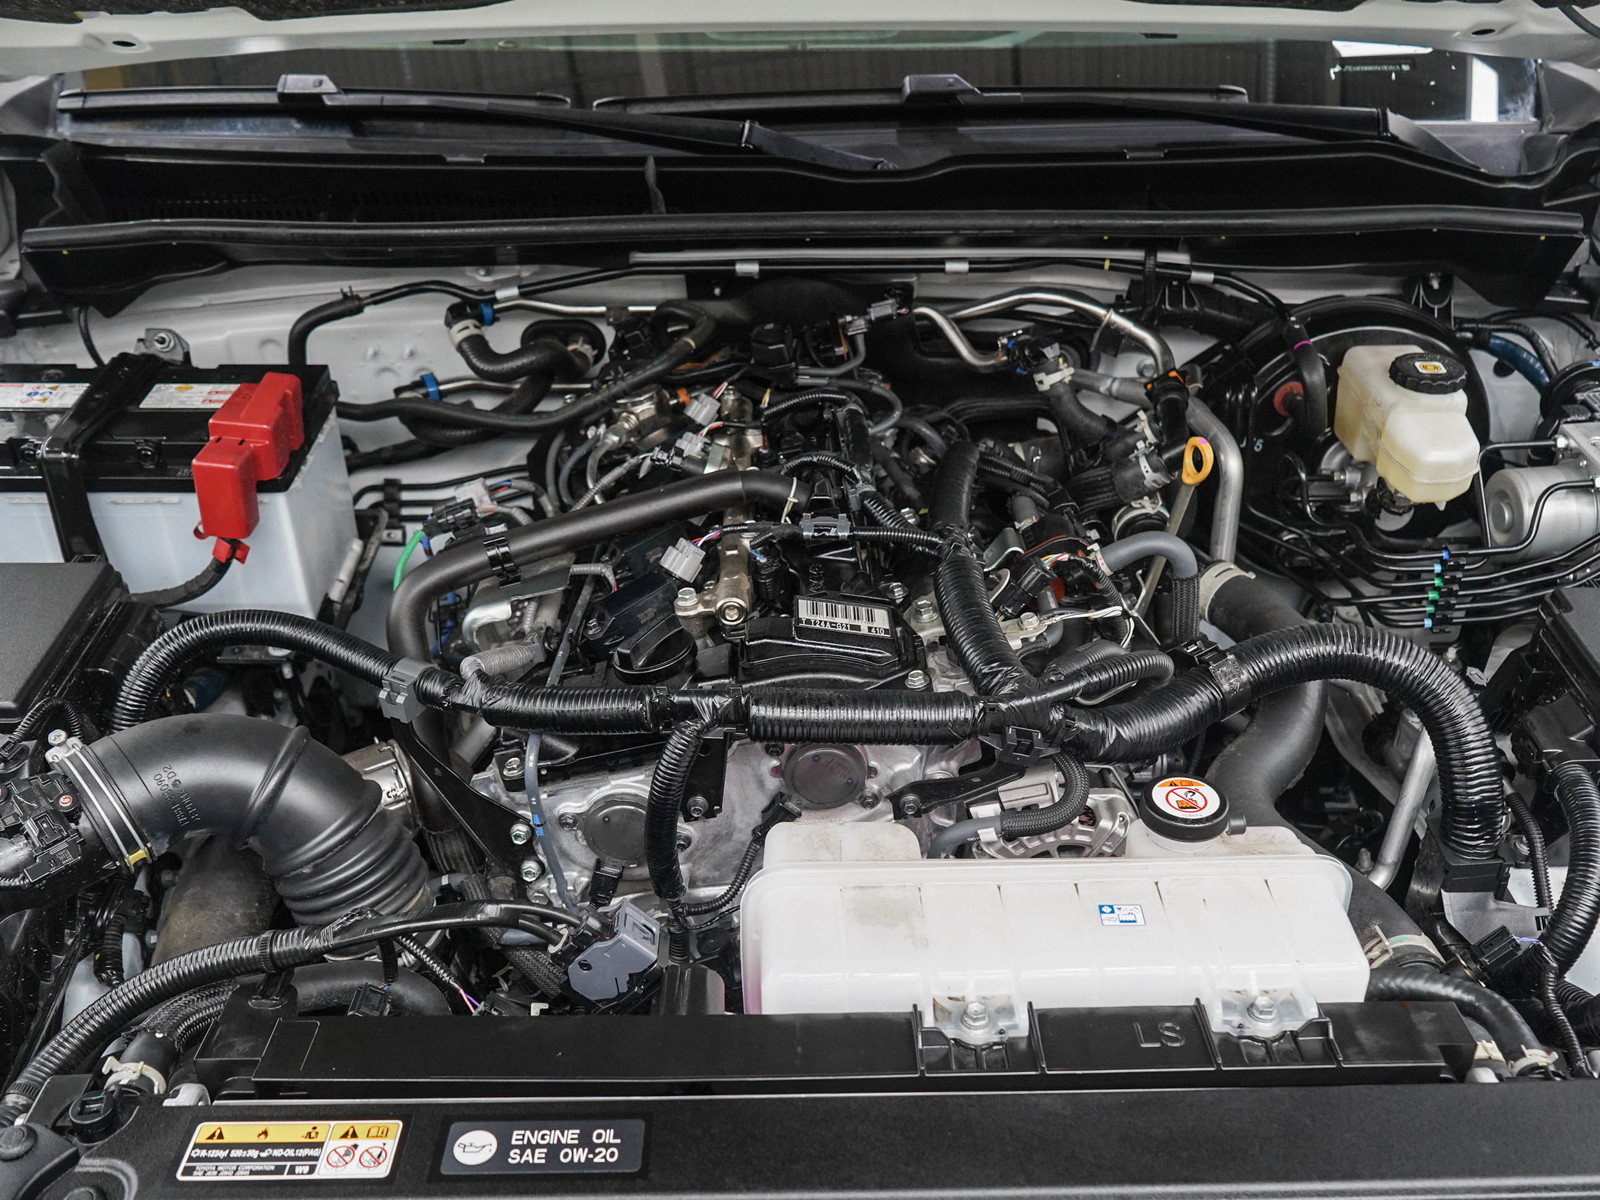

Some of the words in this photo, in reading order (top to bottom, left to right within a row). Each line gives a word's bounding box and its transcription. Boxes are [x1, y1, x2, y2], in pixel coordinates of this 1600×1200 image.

[811, 620, 851, 631] T24A-G21
[1133, 1021, 1185, 1048] LS
[511, 1129, 580, 1145] ENGINE
[592, 1129, 621, 1144] OIL
[507, 1148, 547, 1164] SAE
[559, 1147, 619, 1163] 0W-20
